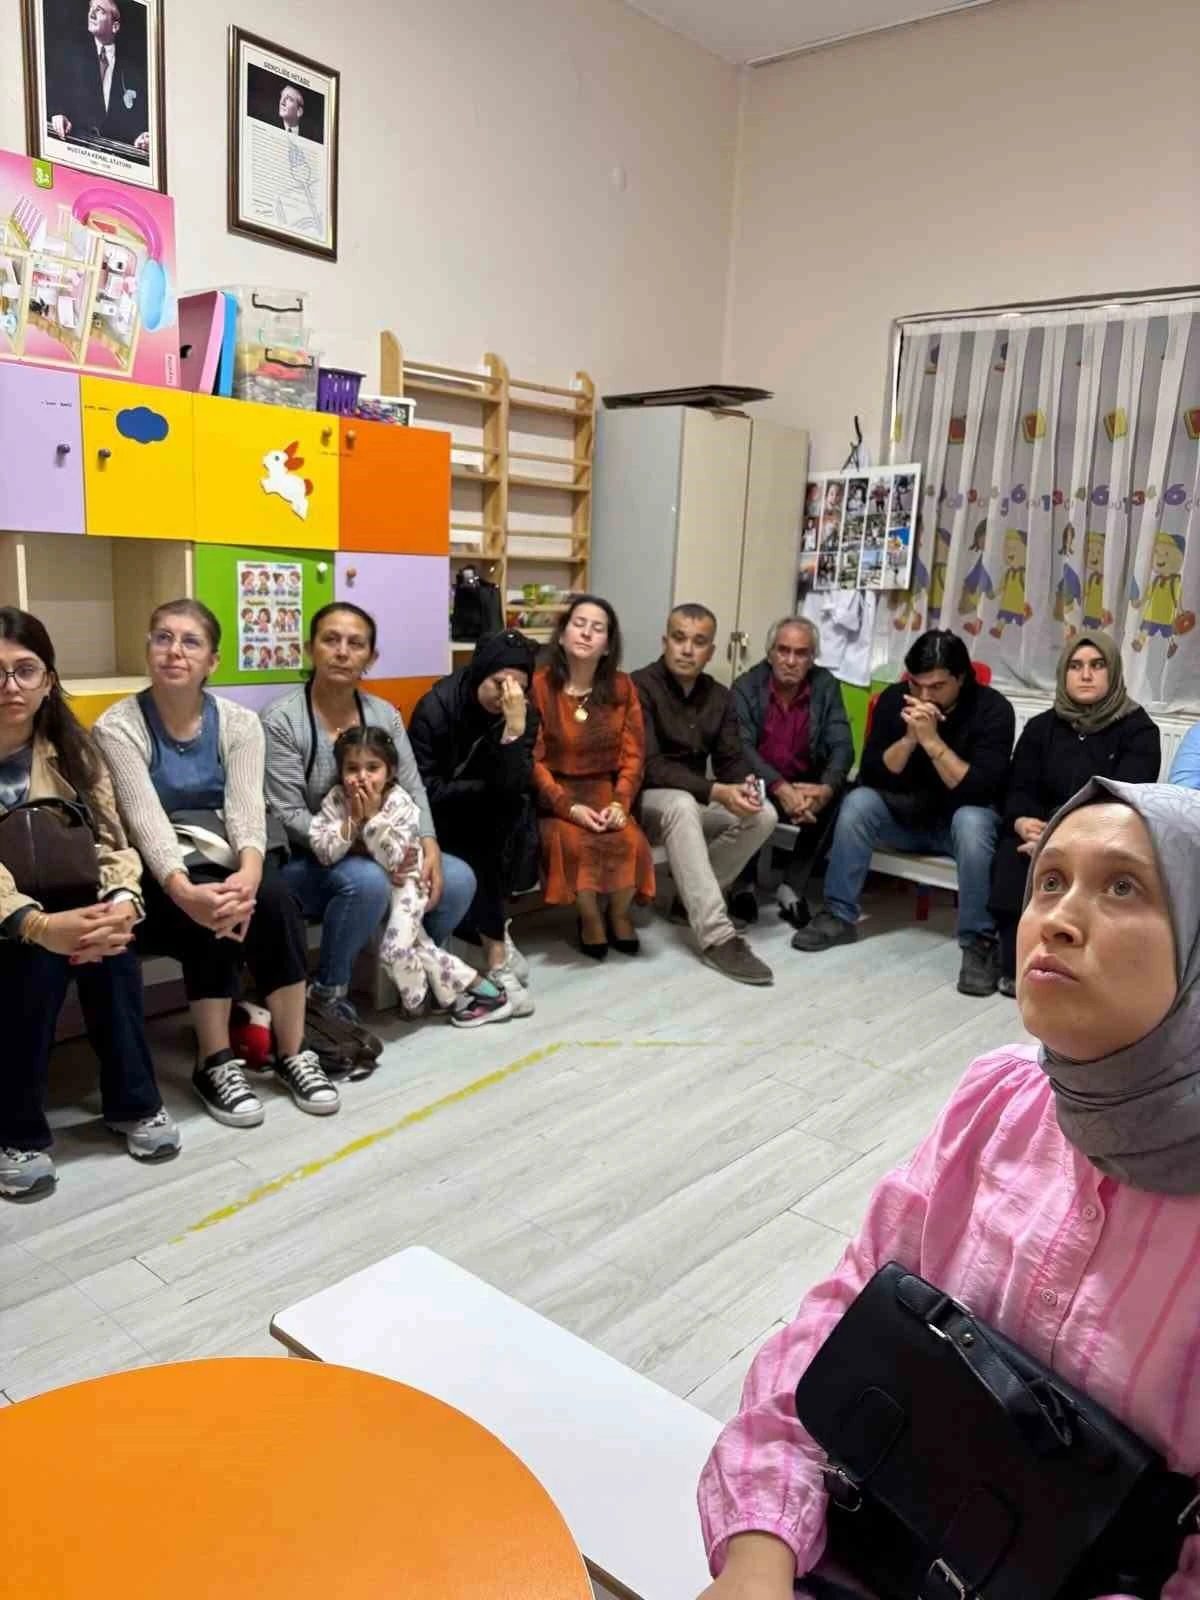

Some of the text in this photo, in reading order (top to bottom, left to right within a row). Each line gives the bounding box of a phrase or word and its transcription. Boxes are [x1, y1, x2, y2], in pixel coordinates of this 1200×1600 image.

[1011, 483, 1026, 505] 6
[1091, 484, 1110, 507] 6
[1163, 483, 1187, 506] 6
